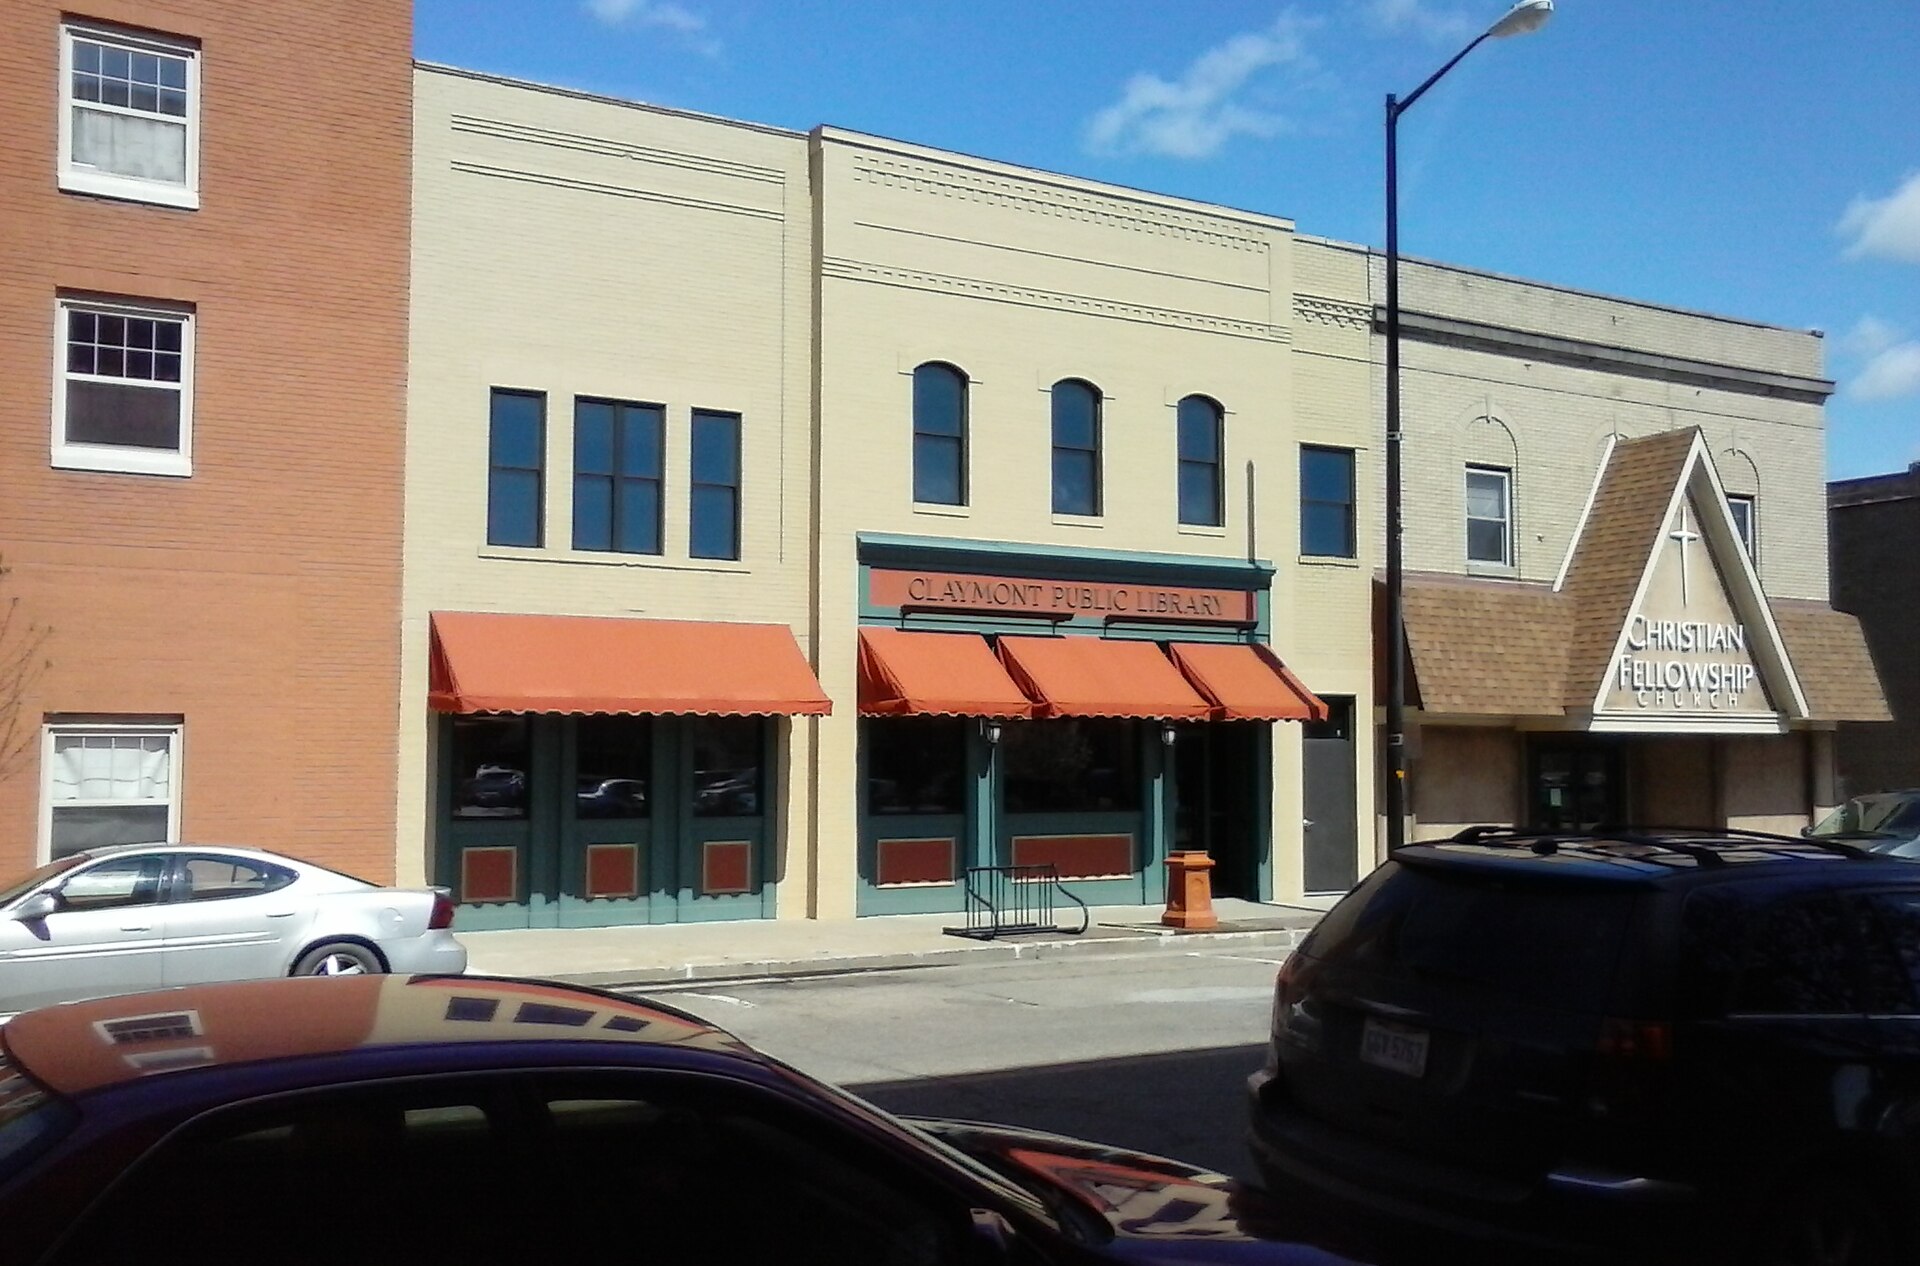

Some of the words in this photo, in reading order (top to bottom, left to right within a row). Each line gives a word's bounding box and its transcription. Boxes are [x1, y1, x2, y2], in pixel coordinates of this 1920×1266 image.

[908, 578, 1043, 607] CLAYMONT
[1052, 586, 1128, 611] PUBLIC
[1136, 590, 1227, 616] LIBRARY
[1626, 614, 1744, 651] CHRISTIAN
[1618, 654, 1754, 691] FELLOWSHIP
[1637, 689, 1738, 708] CHURCH
